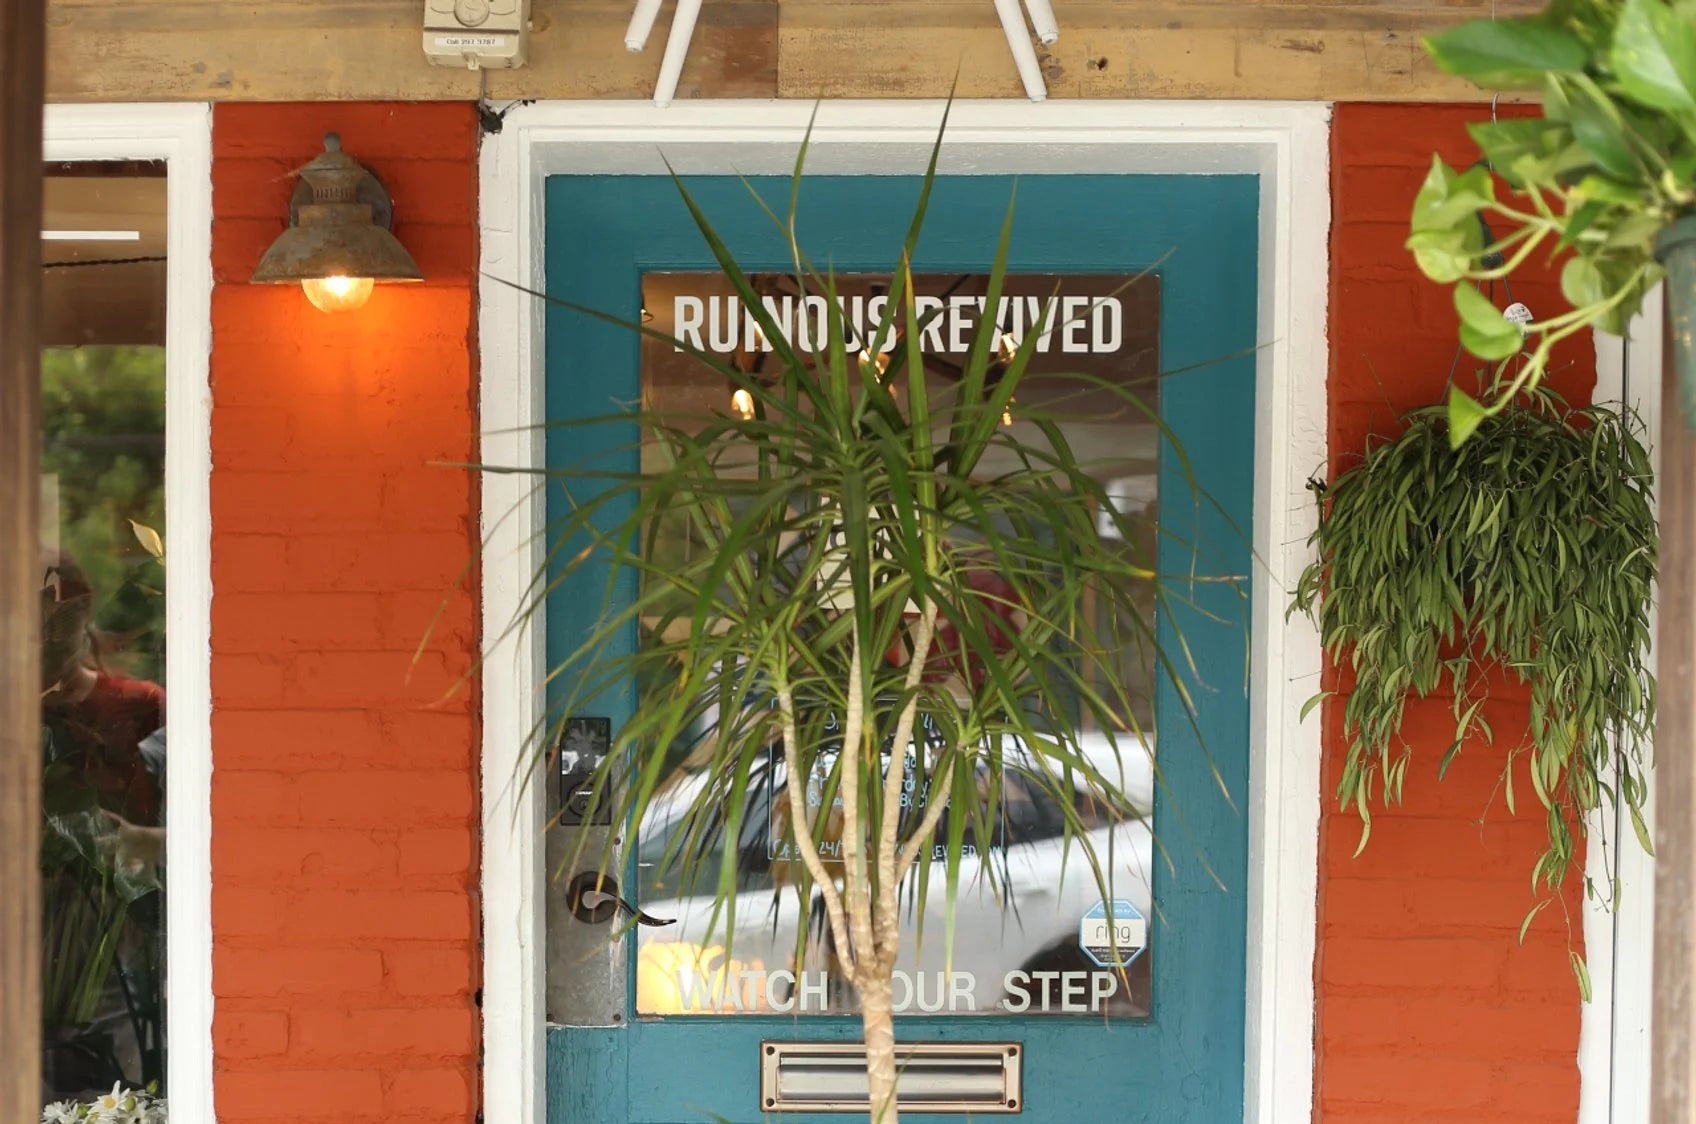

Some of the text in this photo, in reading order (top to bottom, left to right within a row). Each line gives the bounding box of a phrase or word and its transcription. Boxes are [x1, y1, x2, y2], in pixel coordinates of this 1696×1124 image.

[914, 295, 1123, 353] REVIVED
[1095, 922, 1131, 944] ring
[676, 969, 1118, 1013] WATCH OUR STEP
